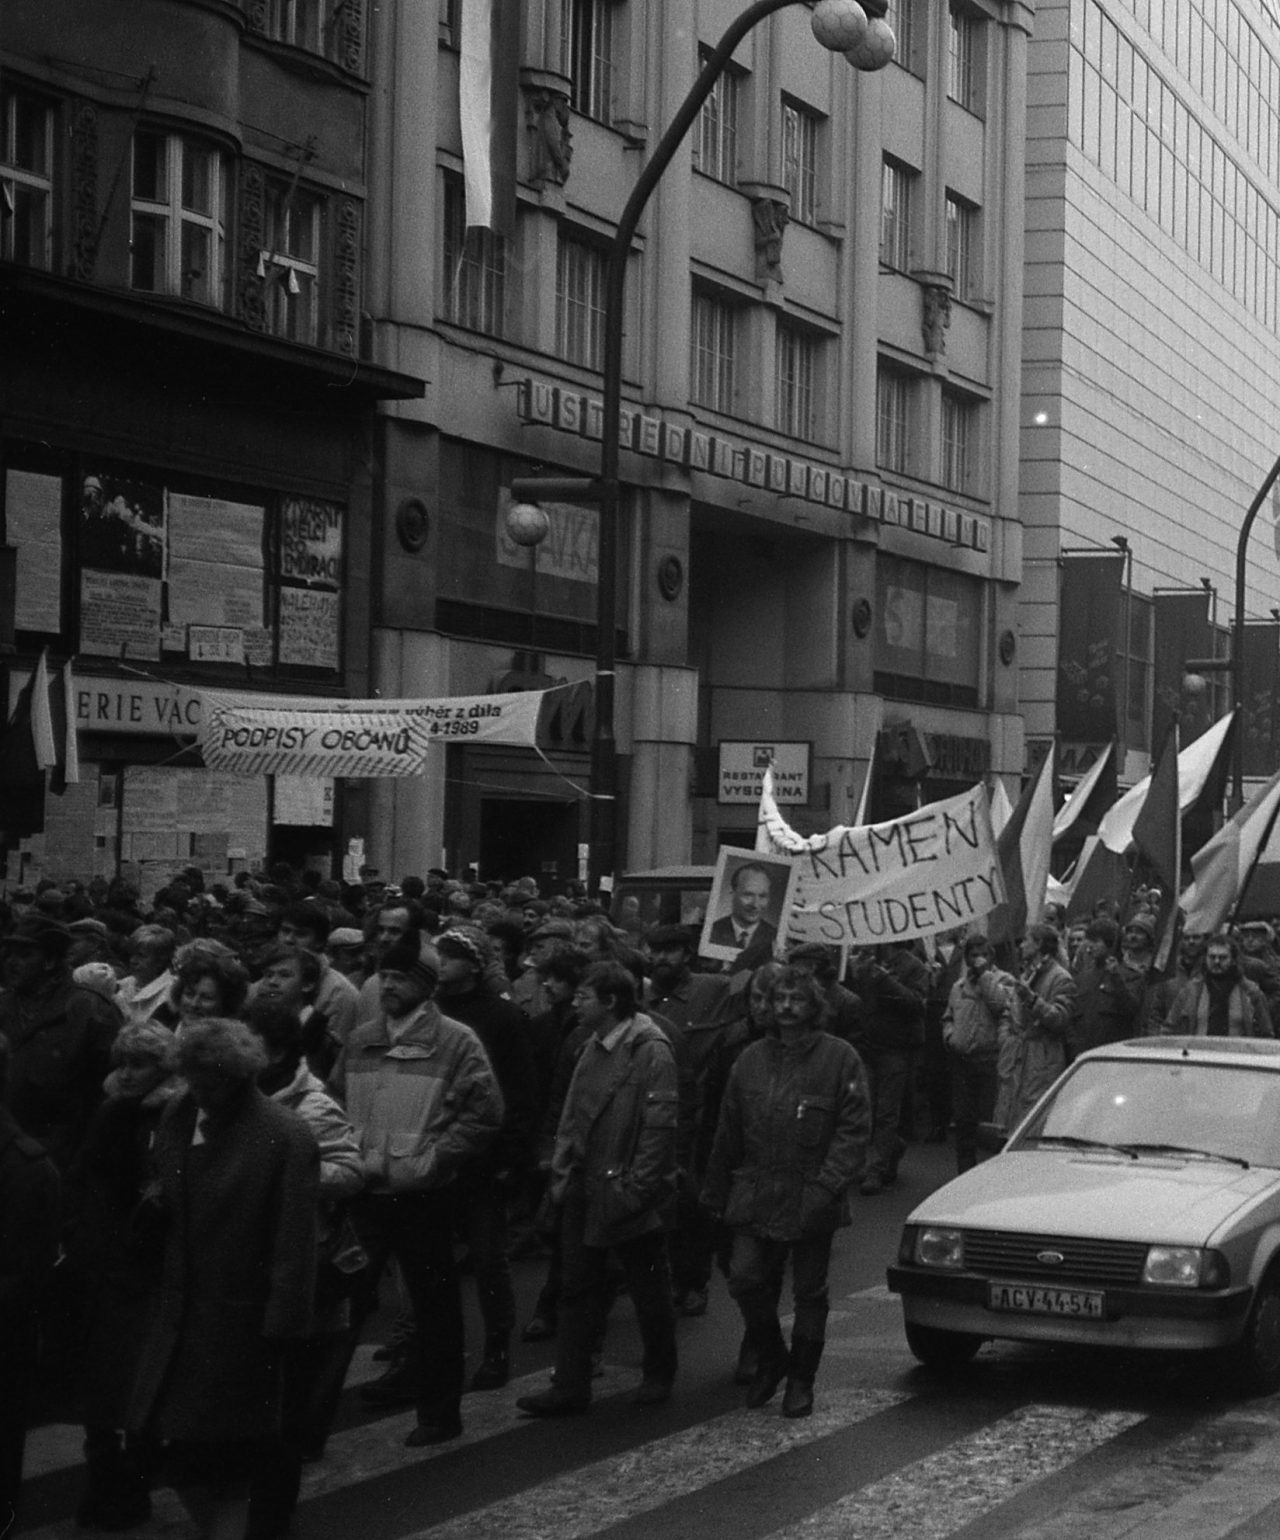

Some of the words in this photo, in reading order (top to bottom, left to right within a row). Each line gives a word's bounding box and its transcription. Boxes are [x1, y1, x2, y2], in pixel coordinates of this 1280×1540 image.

[76, 689, 143, 722] ERIE
[152, 688, 202, 726] VÁC
[221, 727, 318, 750] PODPISY
[320, 725, 410, 755] OBČANŮ
[430, 720, 479, 735] 4-1989
[722, 771, 804, 781] RESTARANT
[722, 785, 803, 797] VYSOINA
[809, 801, 979, 880] KAMEN
[818, 866, 997, 941] STUDENTY
